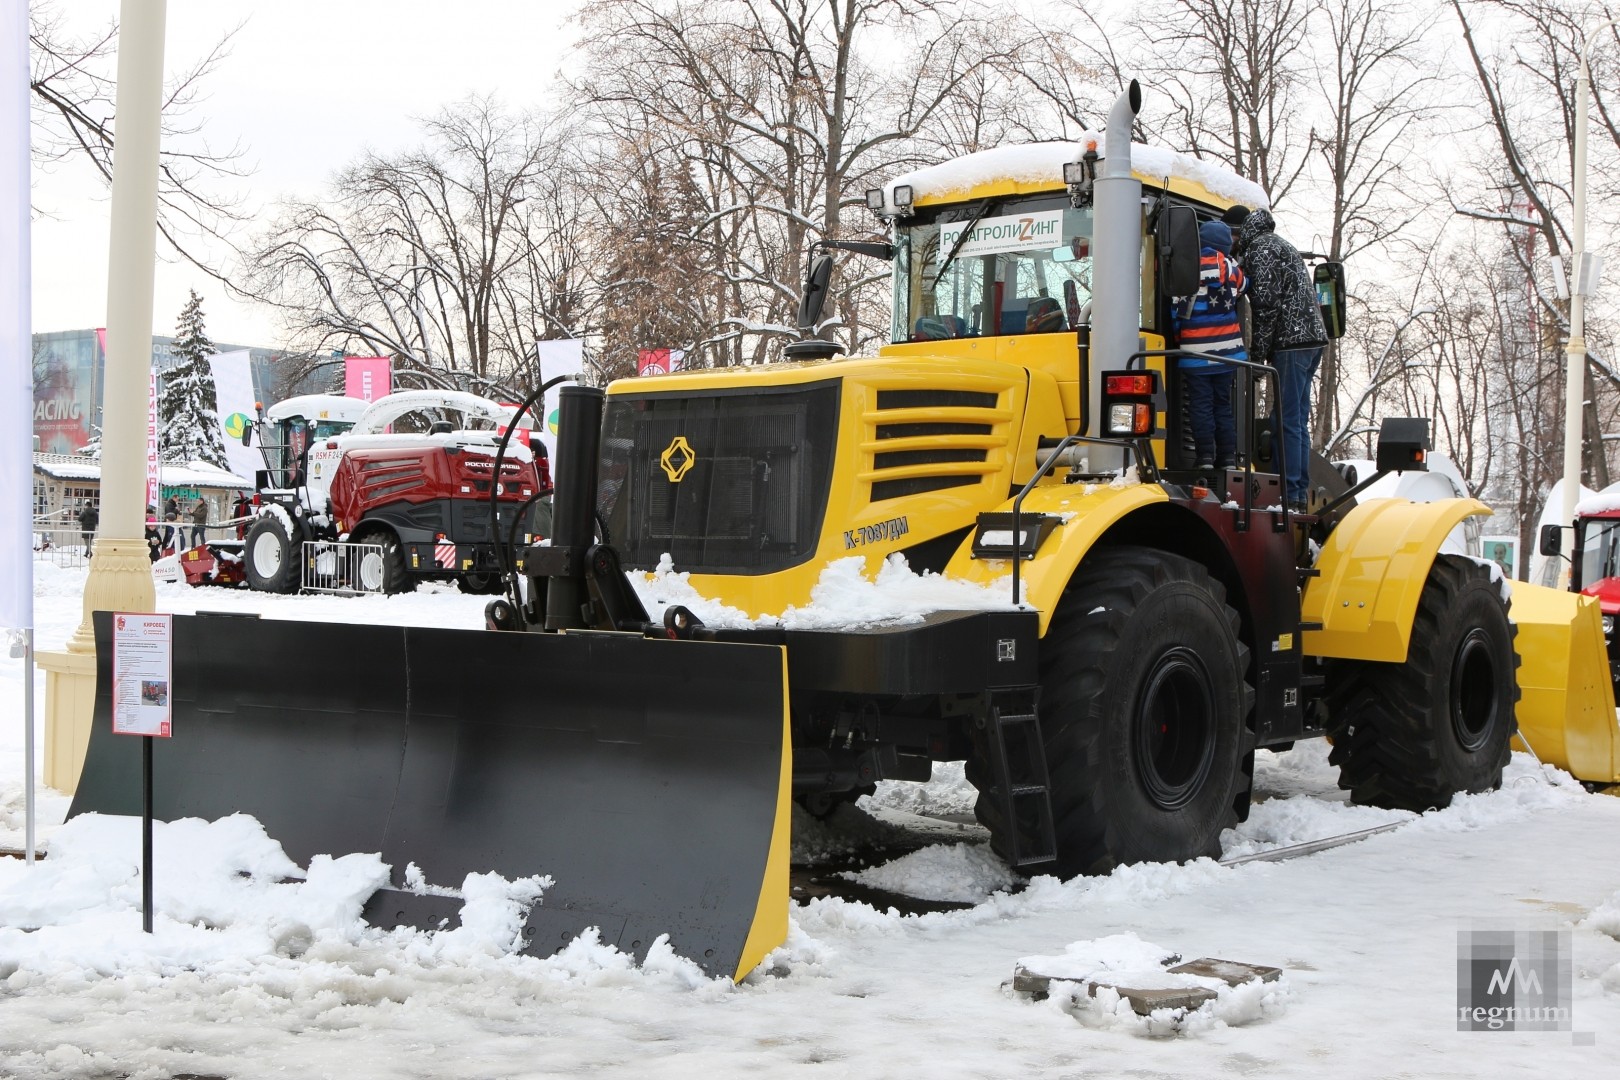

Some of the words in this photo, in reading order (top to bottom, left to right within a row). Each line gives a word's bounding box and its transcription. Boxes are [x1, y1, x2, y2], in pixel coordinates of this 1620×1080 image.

[943, 218, 1059, 246] РОАГРОЛИZИНГ
[33, 399, 80, 421] ACING
[844, 516, 909, 550] К-708УДМ
